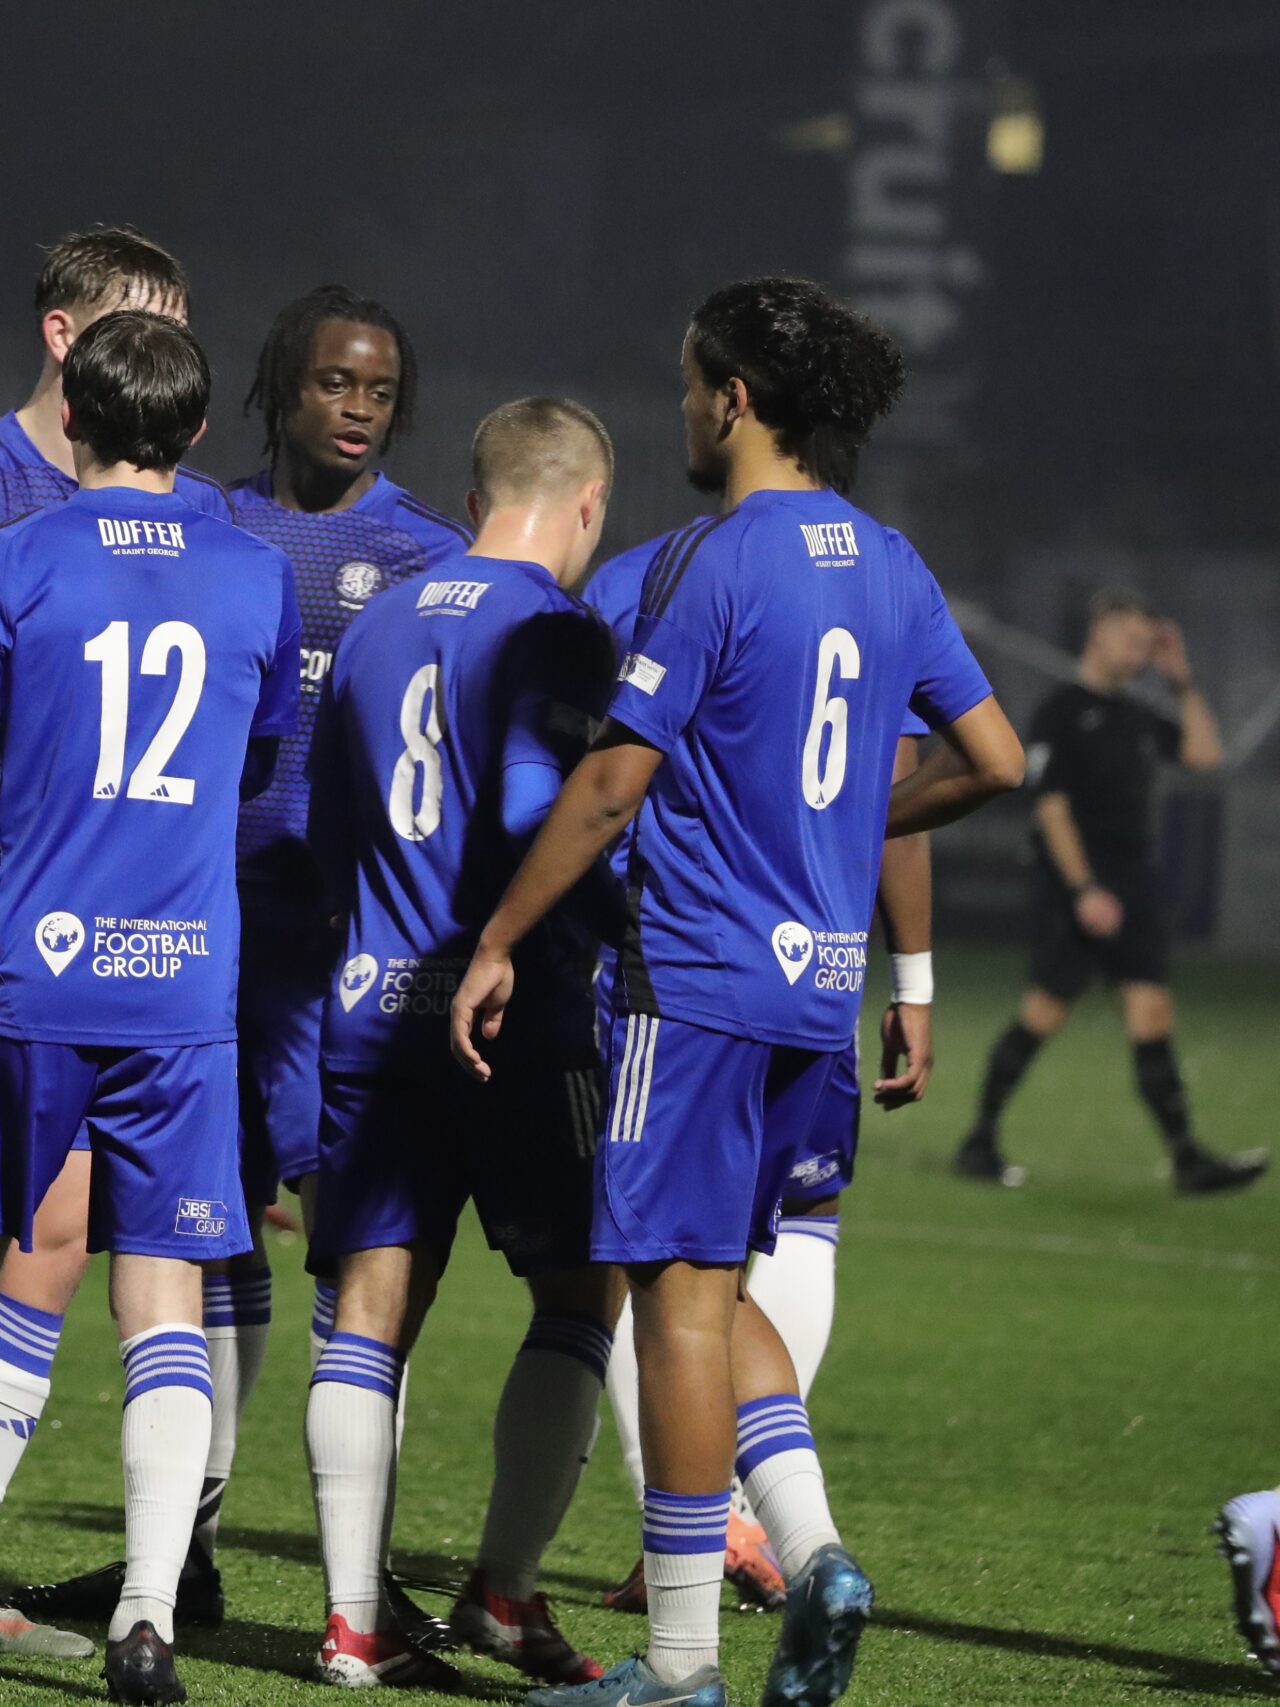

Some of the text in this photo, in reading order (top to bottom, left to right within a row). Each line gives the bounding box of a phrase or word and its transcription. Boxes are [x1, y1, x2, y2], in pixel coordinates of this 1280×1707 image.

[97, 518, 186, 550] DUFFER
[800, 522, 860, 557] DUFFER
[146, 548, 180, 557] GEORGE
[415, 581, 489, 610] DUFFER
[84, 620, 207, 805] 12
[802, 627, 860, 810] 6
[389, 663, 443, 841] 8
[94, 916, 208, 931] THE INTERNATIONAL
[93, 931, 210, 956] FOOTBALL
[92, 955, 182, 978] GROUP
[387, 958, 408, 969] THE
[817, 945, 867, 969] FOOTBA
[381, 971, 458, 993] FOOTB
[814, 968, 863, 992] GROUP
[379, 992, 450, 1015] GROU
[180, 1201, 211, 1218] JBSi
